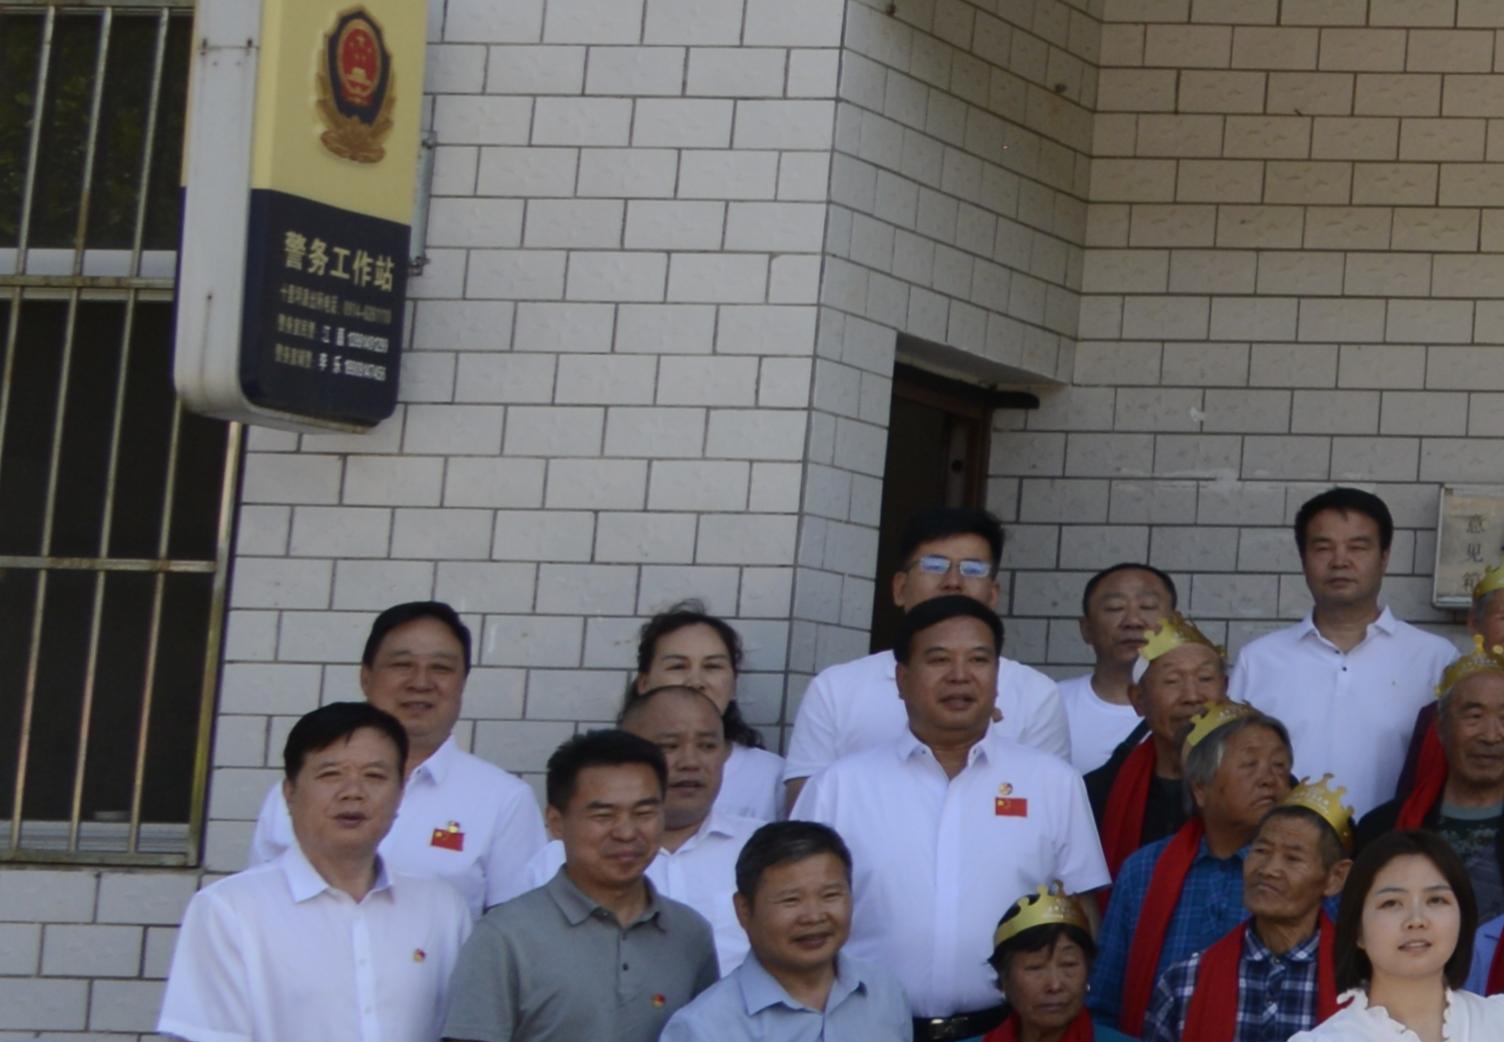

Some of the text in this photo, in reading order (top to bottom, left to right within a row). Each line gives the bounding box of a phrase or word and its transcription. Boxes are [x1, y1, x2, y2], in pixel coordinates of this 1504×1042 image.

[284, 230, 394, 292] 警务工作站
